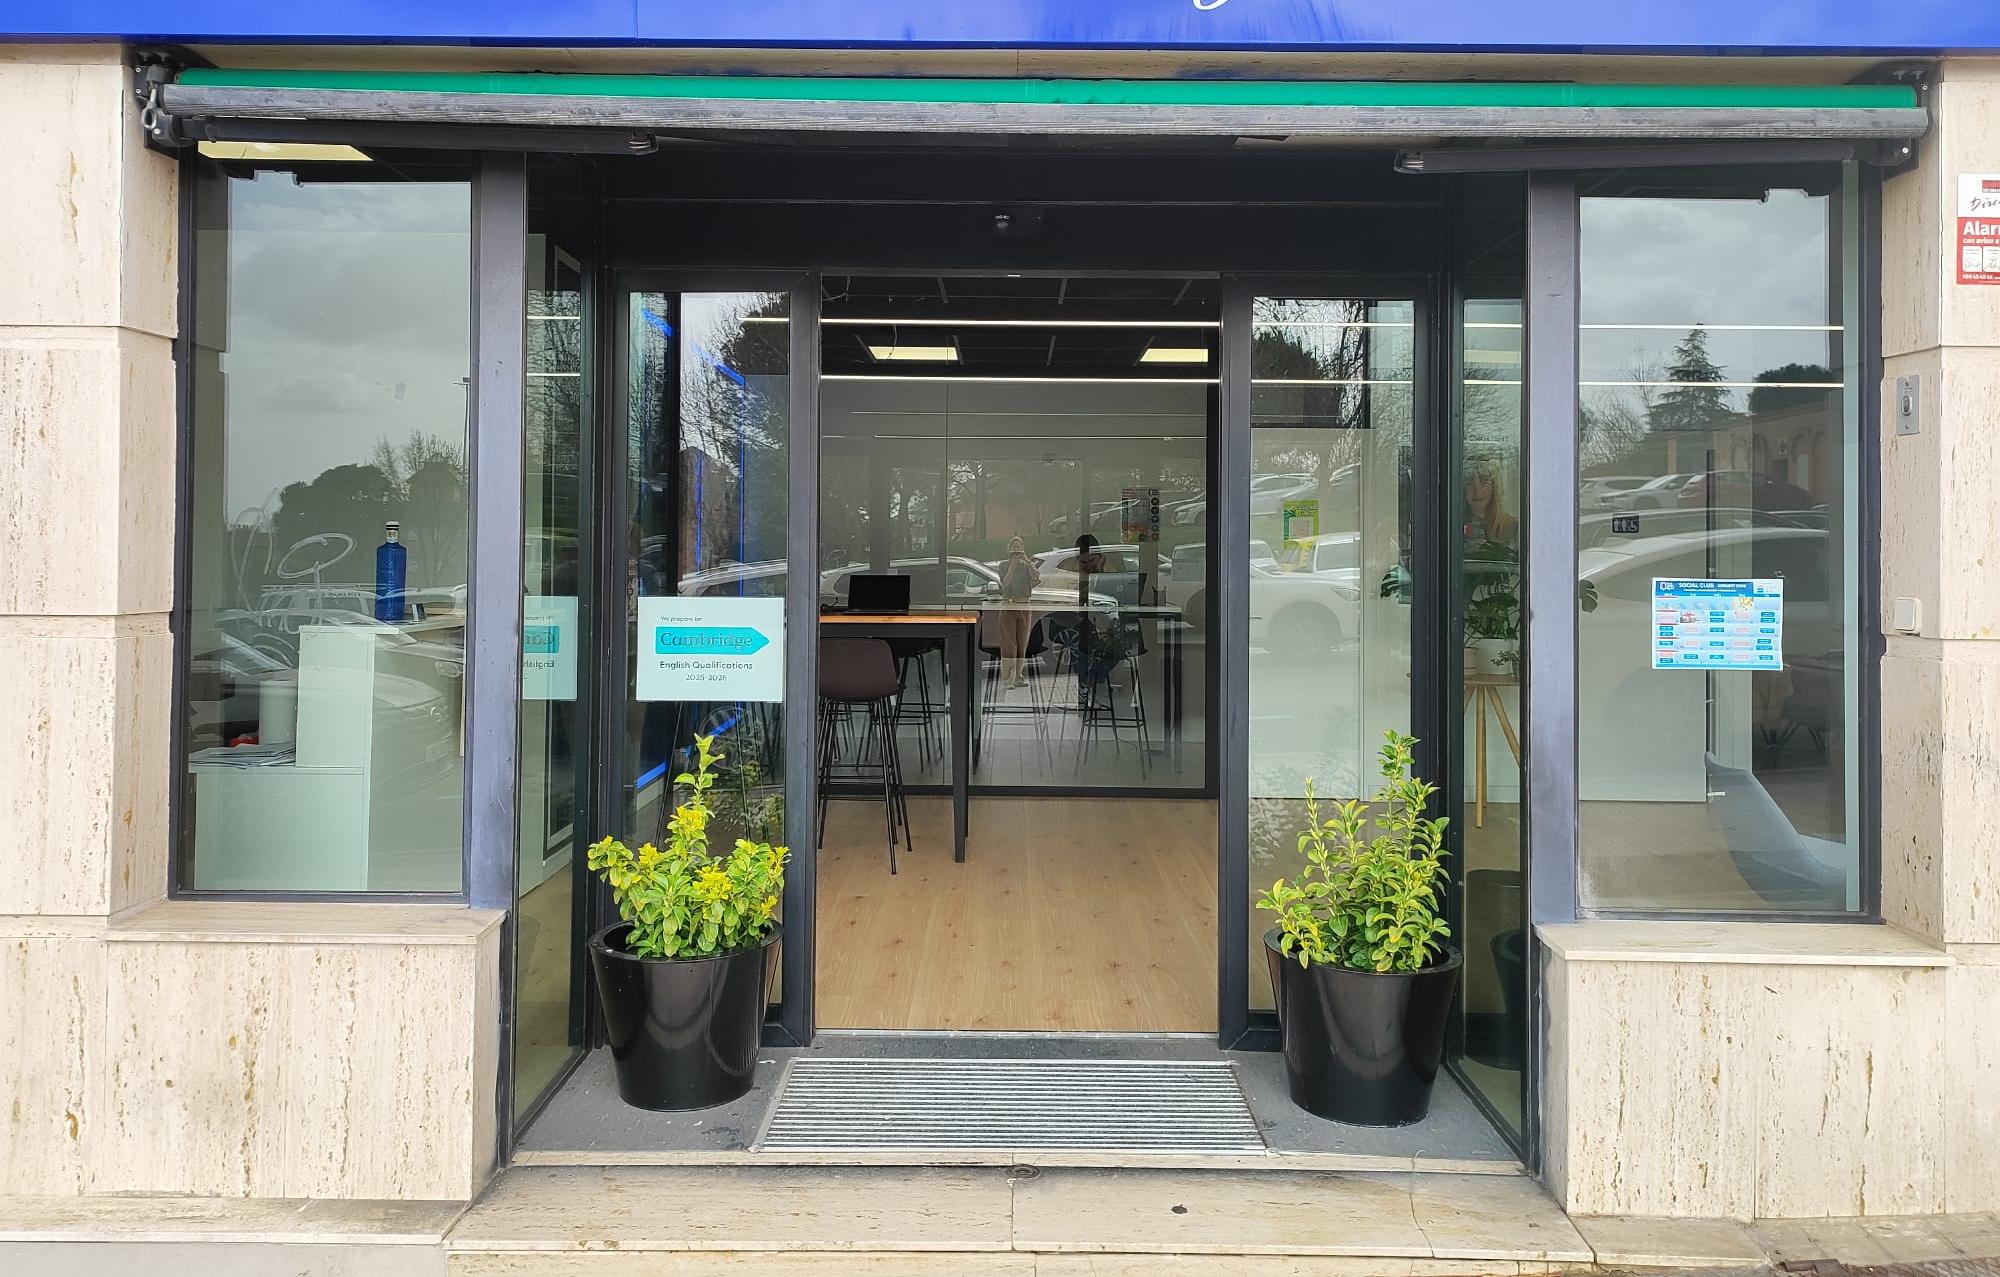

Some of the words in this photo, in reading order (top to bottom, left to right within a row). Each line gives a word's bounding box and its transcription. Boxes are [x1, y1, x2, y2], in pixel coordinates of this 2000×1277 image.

[1962, 220, 2000, 236] Alar
[660, 632, 754, 650] Cambridge
[659, 660, 691, 671] English
[692, 660, 753, 670] Qualifications
